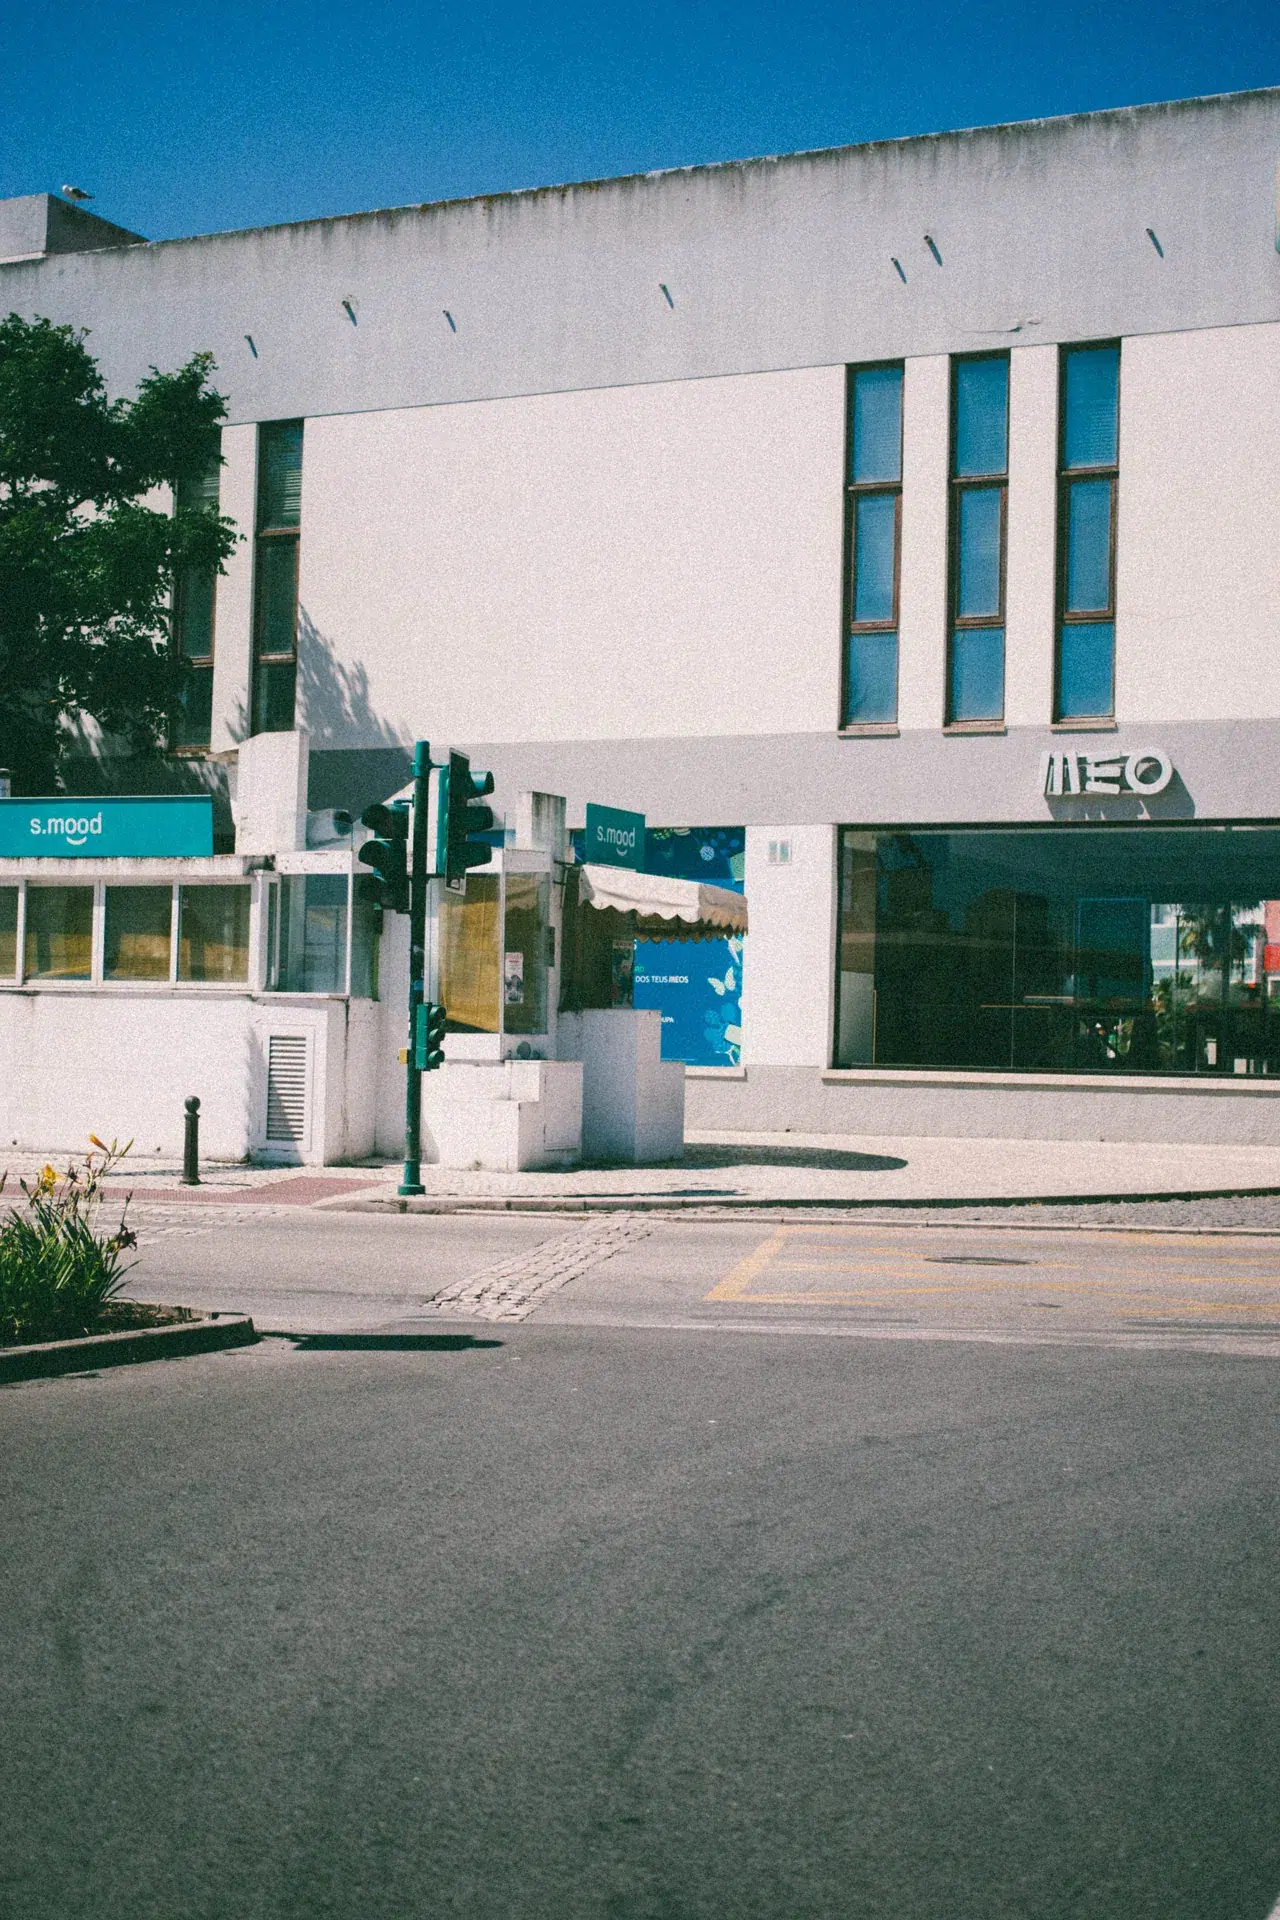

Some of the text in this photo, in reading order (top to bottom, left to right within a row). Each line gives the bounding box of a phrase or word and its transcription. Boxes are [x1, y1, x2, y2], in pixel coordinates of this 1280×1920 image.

[1040, 749, 1173, 795] MEO
[30, 811, 103, 835] s.mood
[597, 825, 636, 848] s.mood
[651, 975, 668, 984] TEUS
